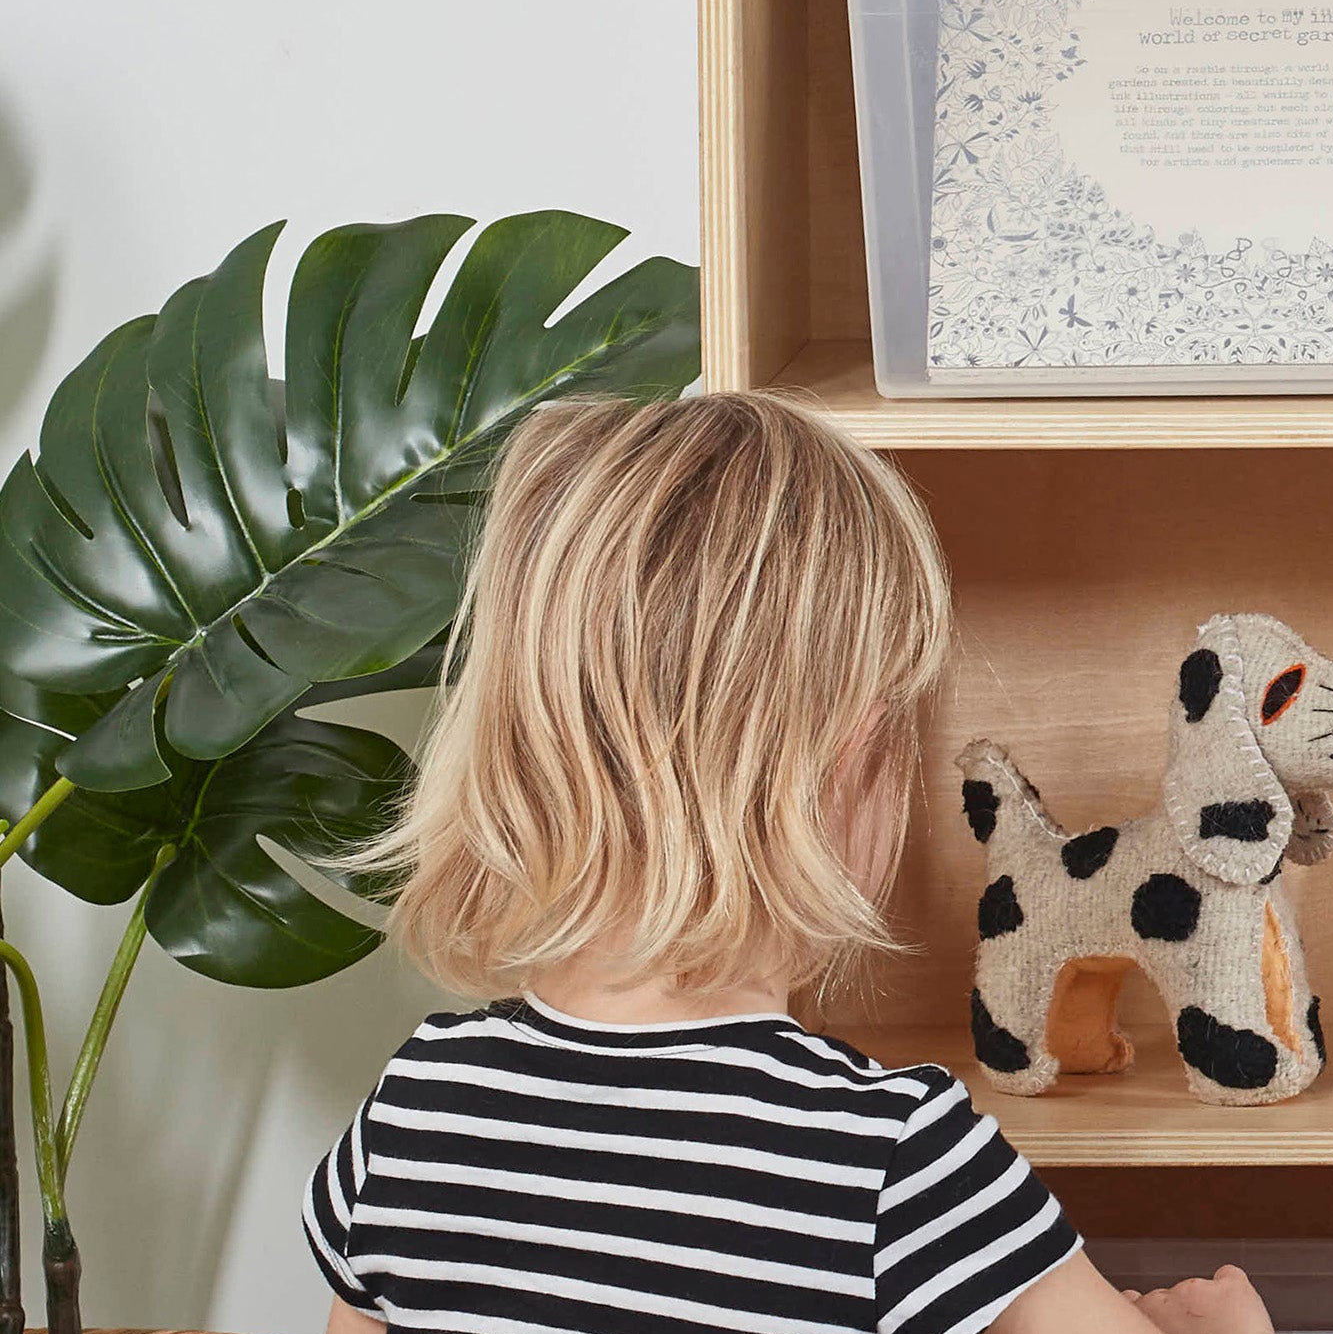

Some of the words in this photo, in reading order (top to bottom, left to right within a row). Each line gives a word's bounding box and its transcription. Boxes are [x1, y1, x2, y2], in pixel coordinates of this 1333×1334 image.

[1169, 8, 1250, 27] Welcome
[1257, 14, 1277, 25] to
[1281, 10, 1304, 26] my
[1139, 29, 1195, 45] world
[1202, 30, 1221, 43] of
[1226, 28, 1291, 43] secret
[1153, 65, 1168, 74] on
[1230, 64, 1278, 76] through
[1299, 63, 1329, 73] world
[1107, 78, 1157, 90] gardens
[1162, 78, 1208, 88] created
[1213, 77, 1226, 87] in
[1231, 76, 1303, 88] beautifully
[1110, 91, 1131, 101] ink
[1136, 91, 1221, 101] illustrations
[1234, 90, 1256, 100] all
[1263, 89, 1310, 102] waiting
[1314, 89, 1327, 99] to
[1113, 104, 1139, 114] life
[1144, 104, 1190, 116] through
[1256, 103, 1274, 113] but
[1280, 102, 1309, 113] each
[1114, 116, 1136, 127] all
[1141, 116, 1176, 127] kinds
[1181, 116, 1195, 127] of
[1200, 116, 1226, 129] tiny
[1230, 115, 1290, 126] creatures
[1191, 130, 1223, 141] there
[1228, 131, 1249, 140] are
[1254, 129, 1281, 140] also
[1315, 128, 1328, 139] of
[1119, 143, 1146, 154] that
[1150, 143, 1181, 154] still
[1187, 143, 1214, 154] need
[1220, 143, 1233, 153] to
[1237, 142, 1250, 153] be
[1254, 142, 1314, 155] completed
[1320, 142, 1333, 154] by
[1164, 156, 1210, 167] artists
[1215, 156, 1237, 167] and
[1241, 155, 1304, 169] gardeners
[1308, 155, 1322, 166] of
